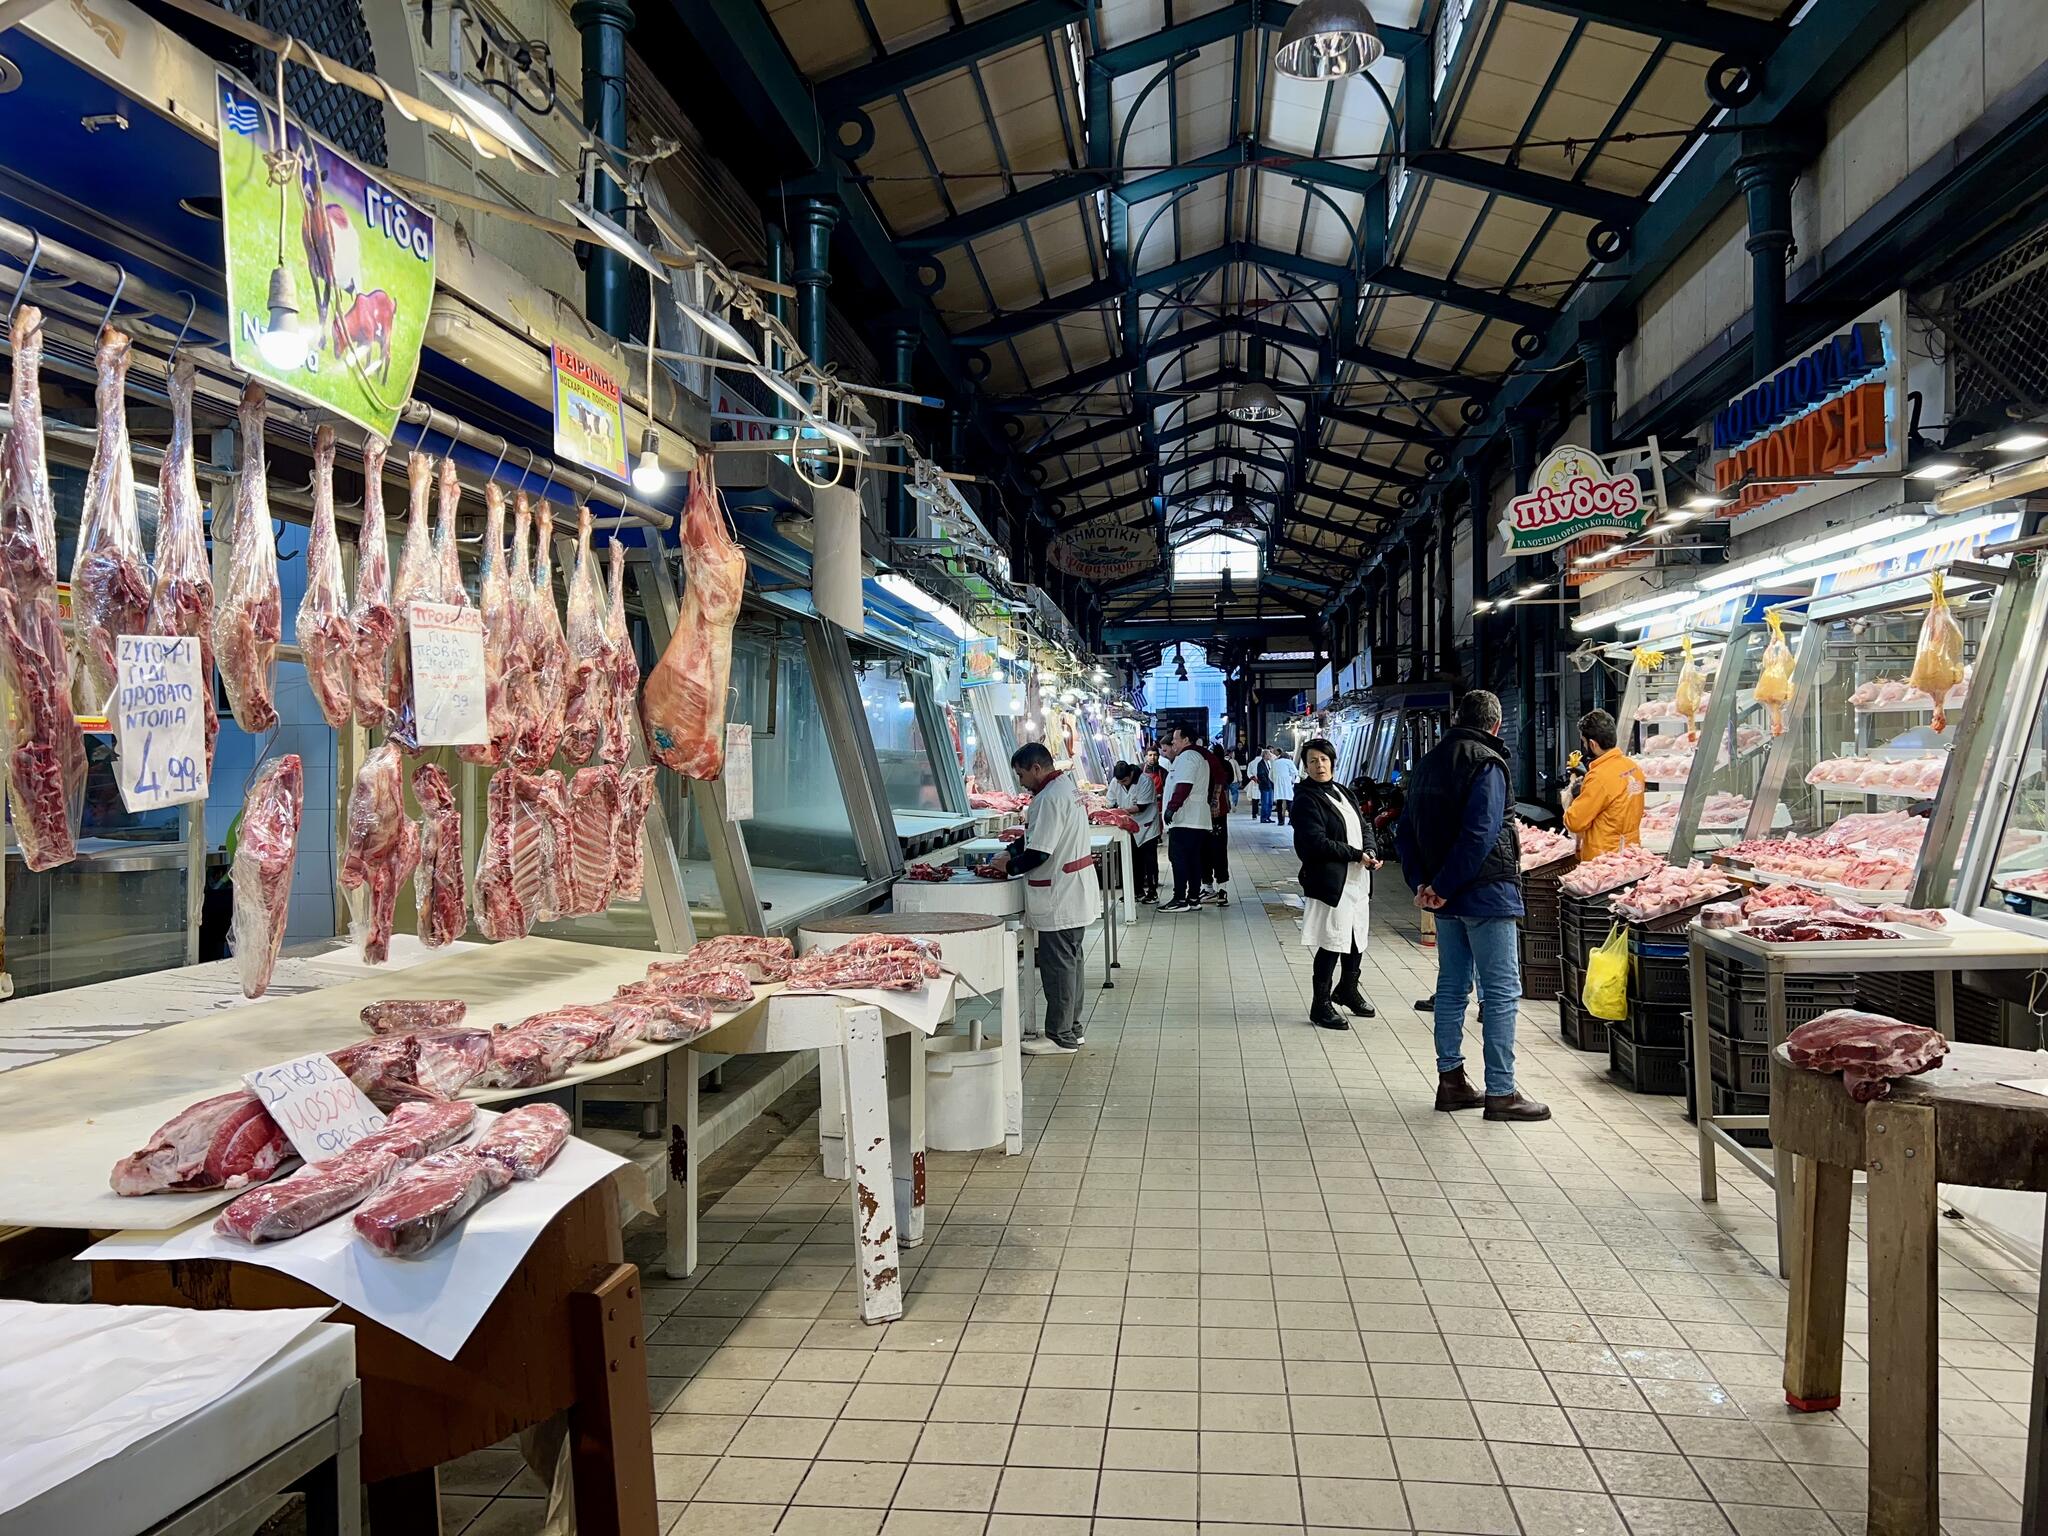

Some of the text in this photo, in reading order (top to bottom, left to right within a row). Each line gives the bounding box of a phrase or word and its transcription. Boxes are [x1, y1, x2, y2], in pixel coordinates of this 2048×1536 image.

[365, 186, 430, 262] Γίδα
[557, 347, 617, 396] ΤΣΙΡΩΝΗΣ
[1714, 323, 1886, 450] ΚΟΤΟΠΟΥΛΑ
[1514, 477, 1637, 529] πίνδος
[1065, 527, 1140, 545] ΔΗΜΟΤΙΚΗ
[1516, 517, 1638, 548] ΤΑ ΝΟΣΤΙΜΑ ΟΡΕΙΝΑ ΚΟΤΟΠΟΥΛΑ
[121, 640, 191, 664] ΖΥΓΟΥΡΙ
[128, 664, 169, 685] ΓΙΔΑ
[122, 683, 192, 711] ΠΡΟΒΑΤΟ
[126, 707, 187, 731] ΝΤΟΠΙΑ
[255, 1058, 346, 1104] ΣΤΗΘΟΣ
